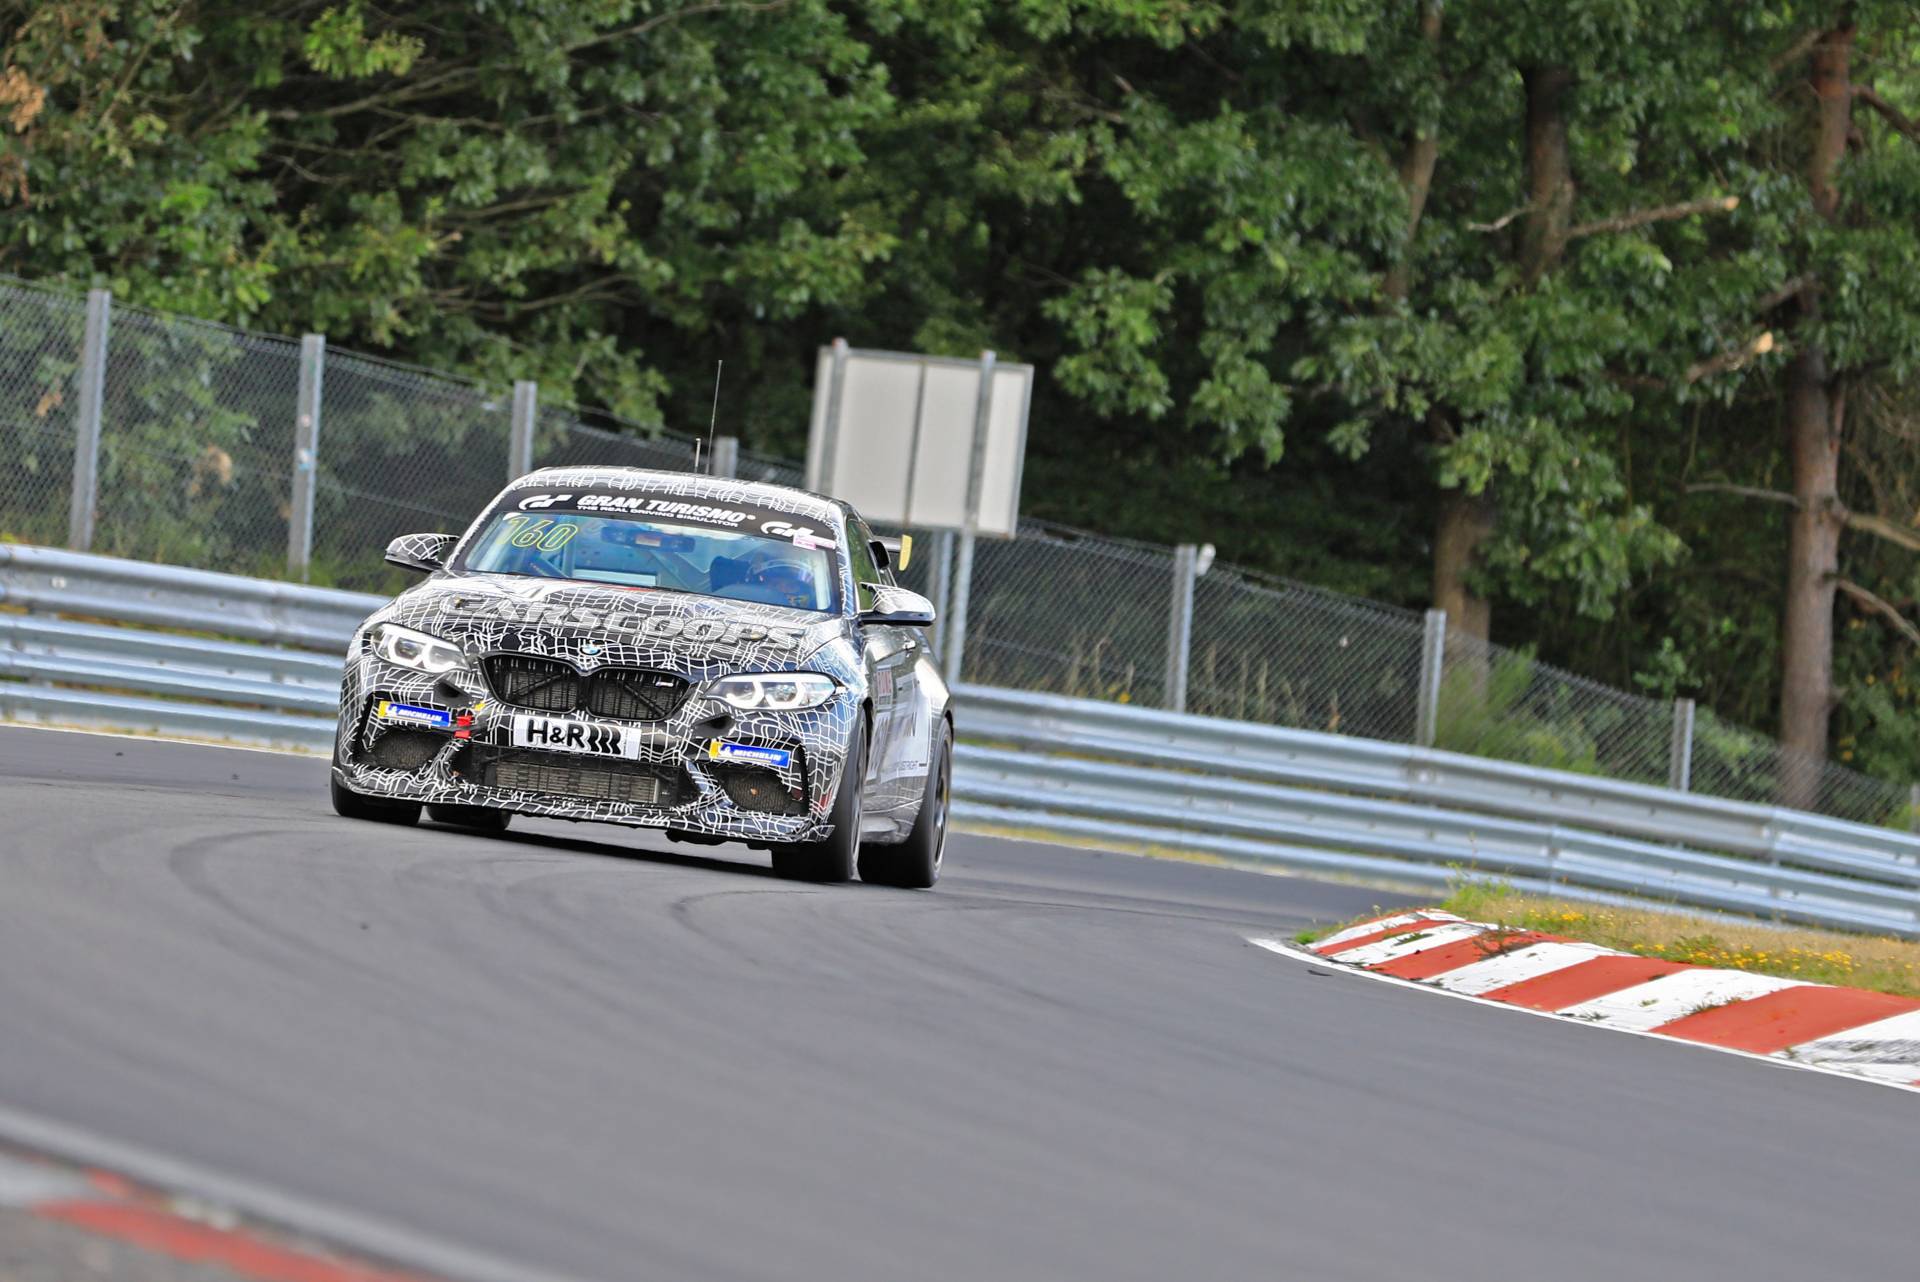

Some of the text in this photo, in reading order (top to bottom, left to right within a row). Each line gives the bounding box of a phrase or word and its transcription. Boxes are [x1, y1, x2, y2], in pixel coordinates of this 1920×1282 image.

[577, 494, 747, 522] GRAN TURISMO
[630, 508, 674, 518] DRIVING
[676, 514, 739, 528] SIMULATOR
[505, 515, 578, 552] 160
[443, 594, 806, 650] CARSCOOPS
[398, 708, 443, 722] MICHELIN
[733, 748, 782, 761] MICHELIN
